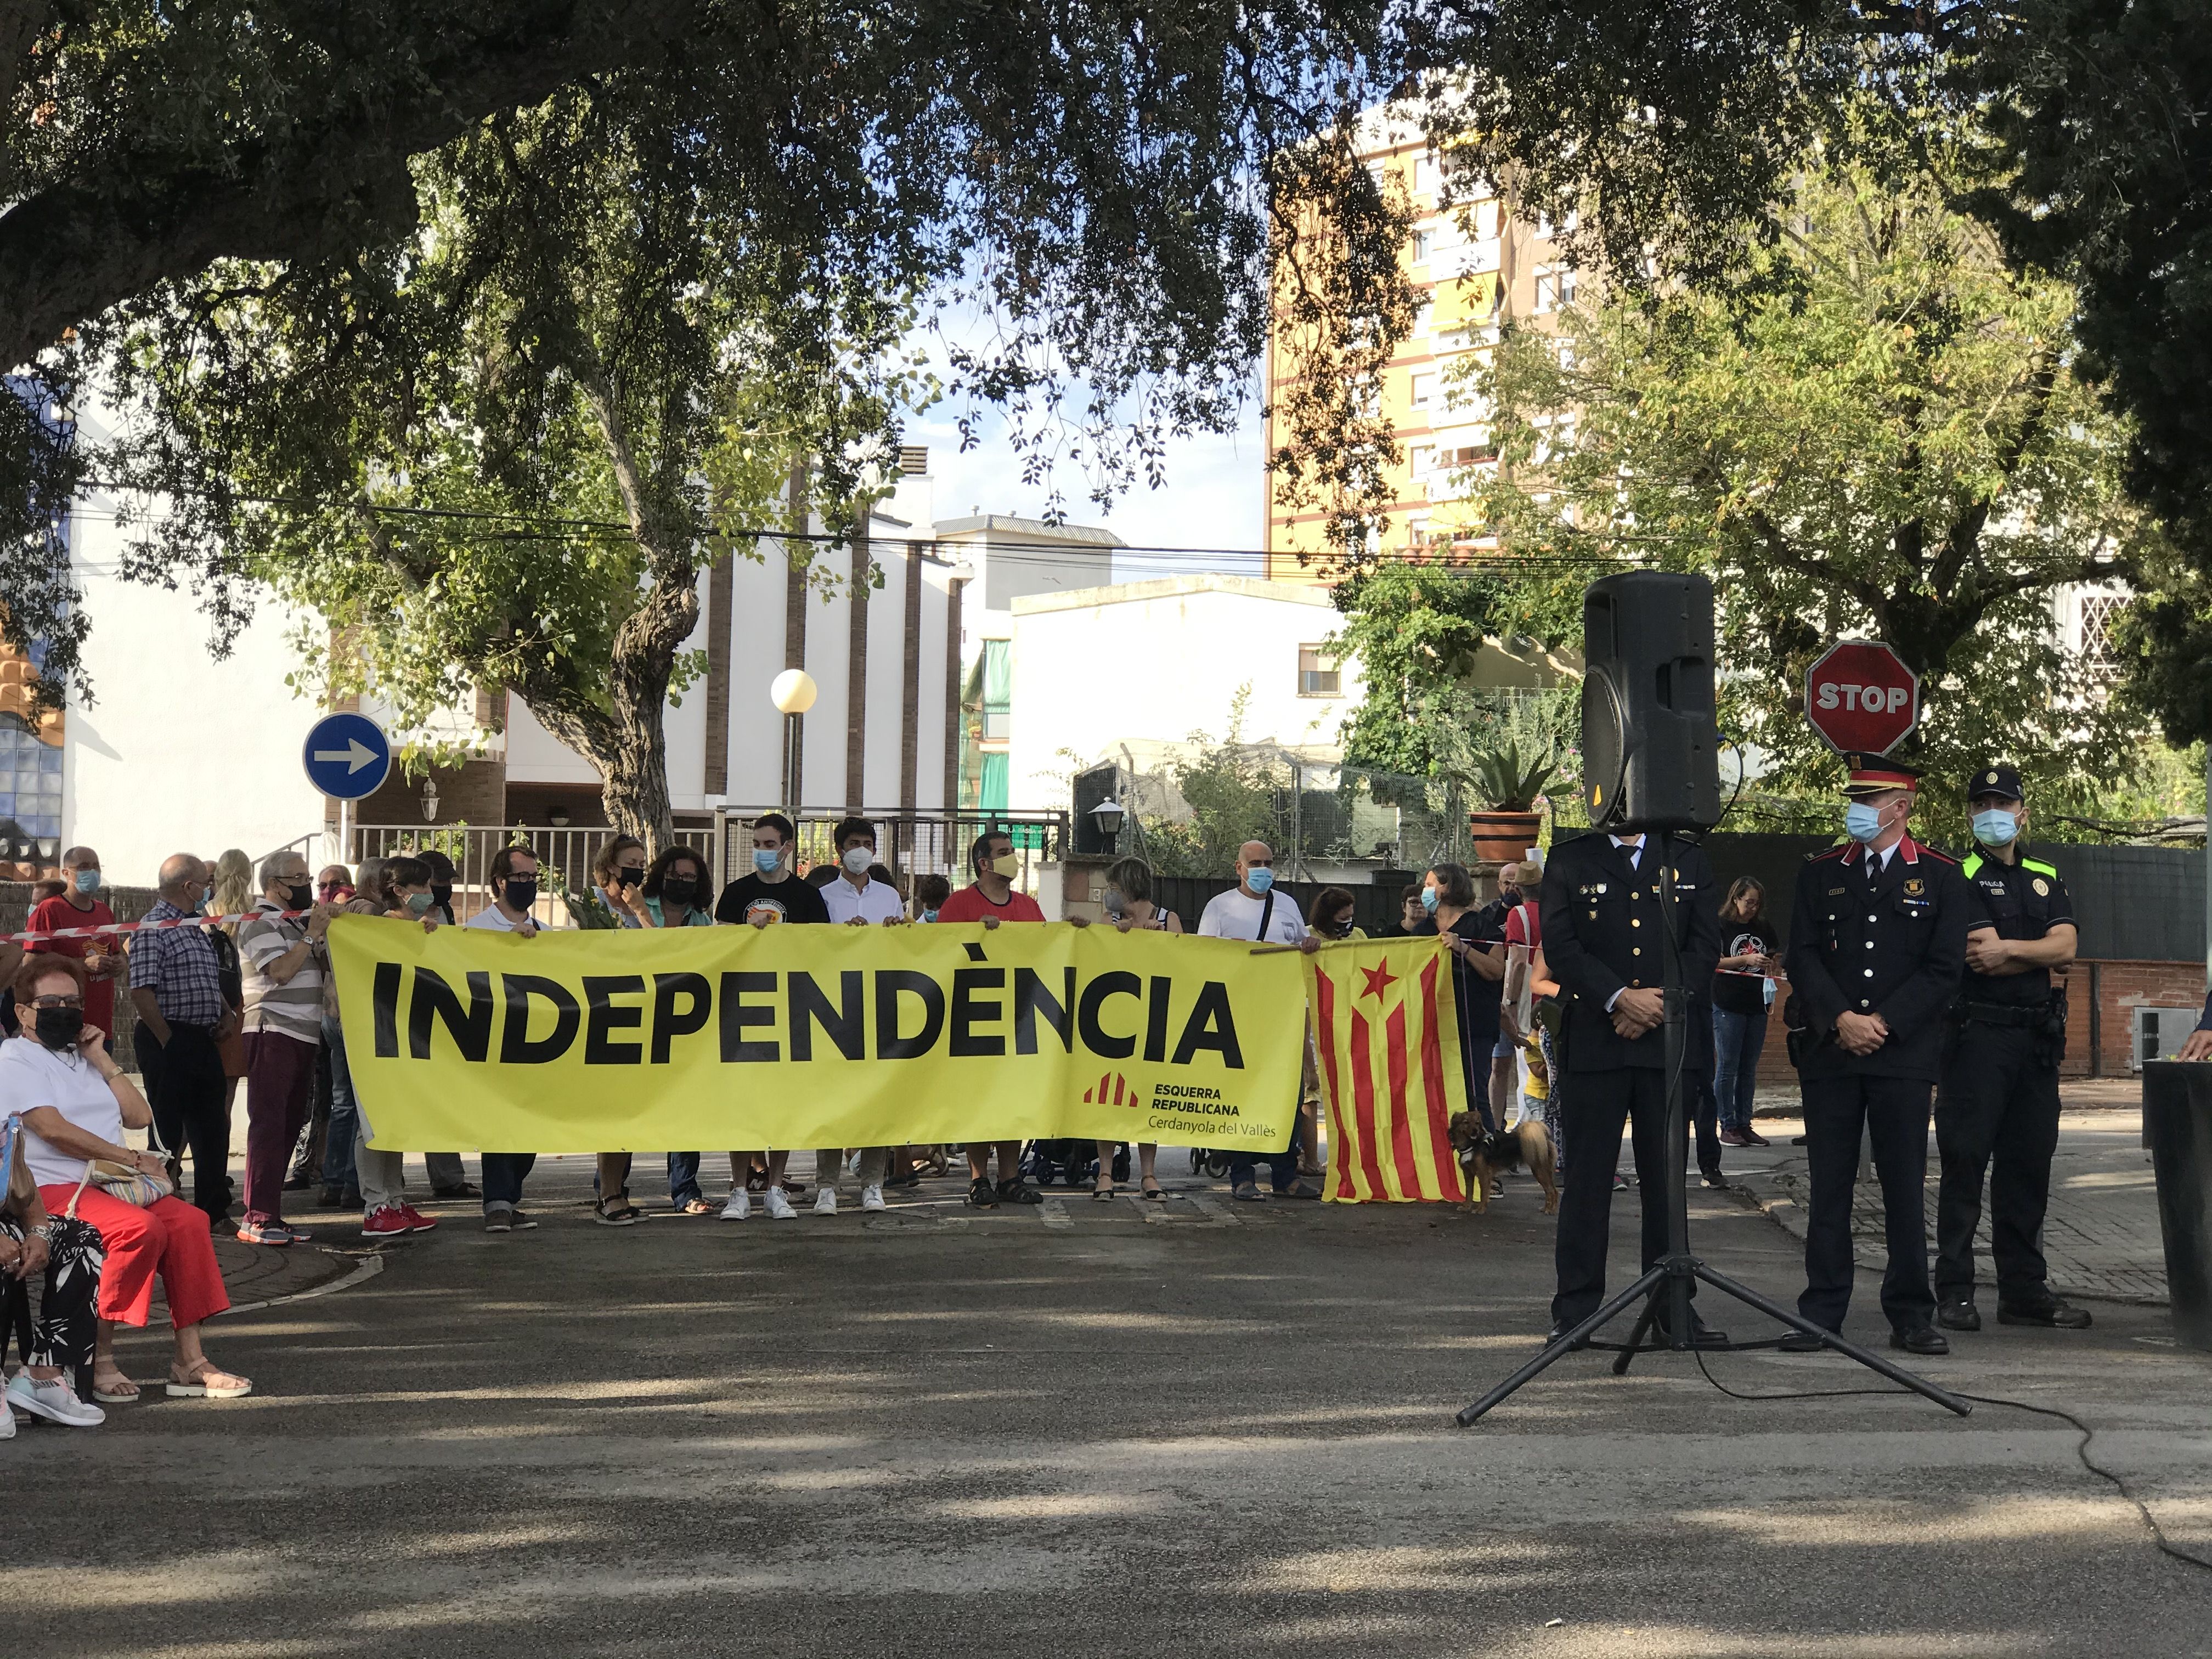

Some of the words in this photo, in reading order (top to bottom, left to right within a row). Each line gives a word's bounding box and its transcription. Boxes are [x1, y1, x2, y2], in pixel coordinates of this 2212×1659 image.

[1816, 682, 1908, 714] STOP
[1093, 888, 1101, 901] 3
[373, 943, 1244, 1069] INDEPENDÈNCIA
[1155, 1084, 1221, 1099] ESQUERRA
[1152, 1099, 1240, 1117] REPUBLICANA
[1149, 1115, 1215, 1135] Cerdanyola
[1218, 1122, 1238, 1135] del
[1240, 1123, 1276, 1137] Vallès
